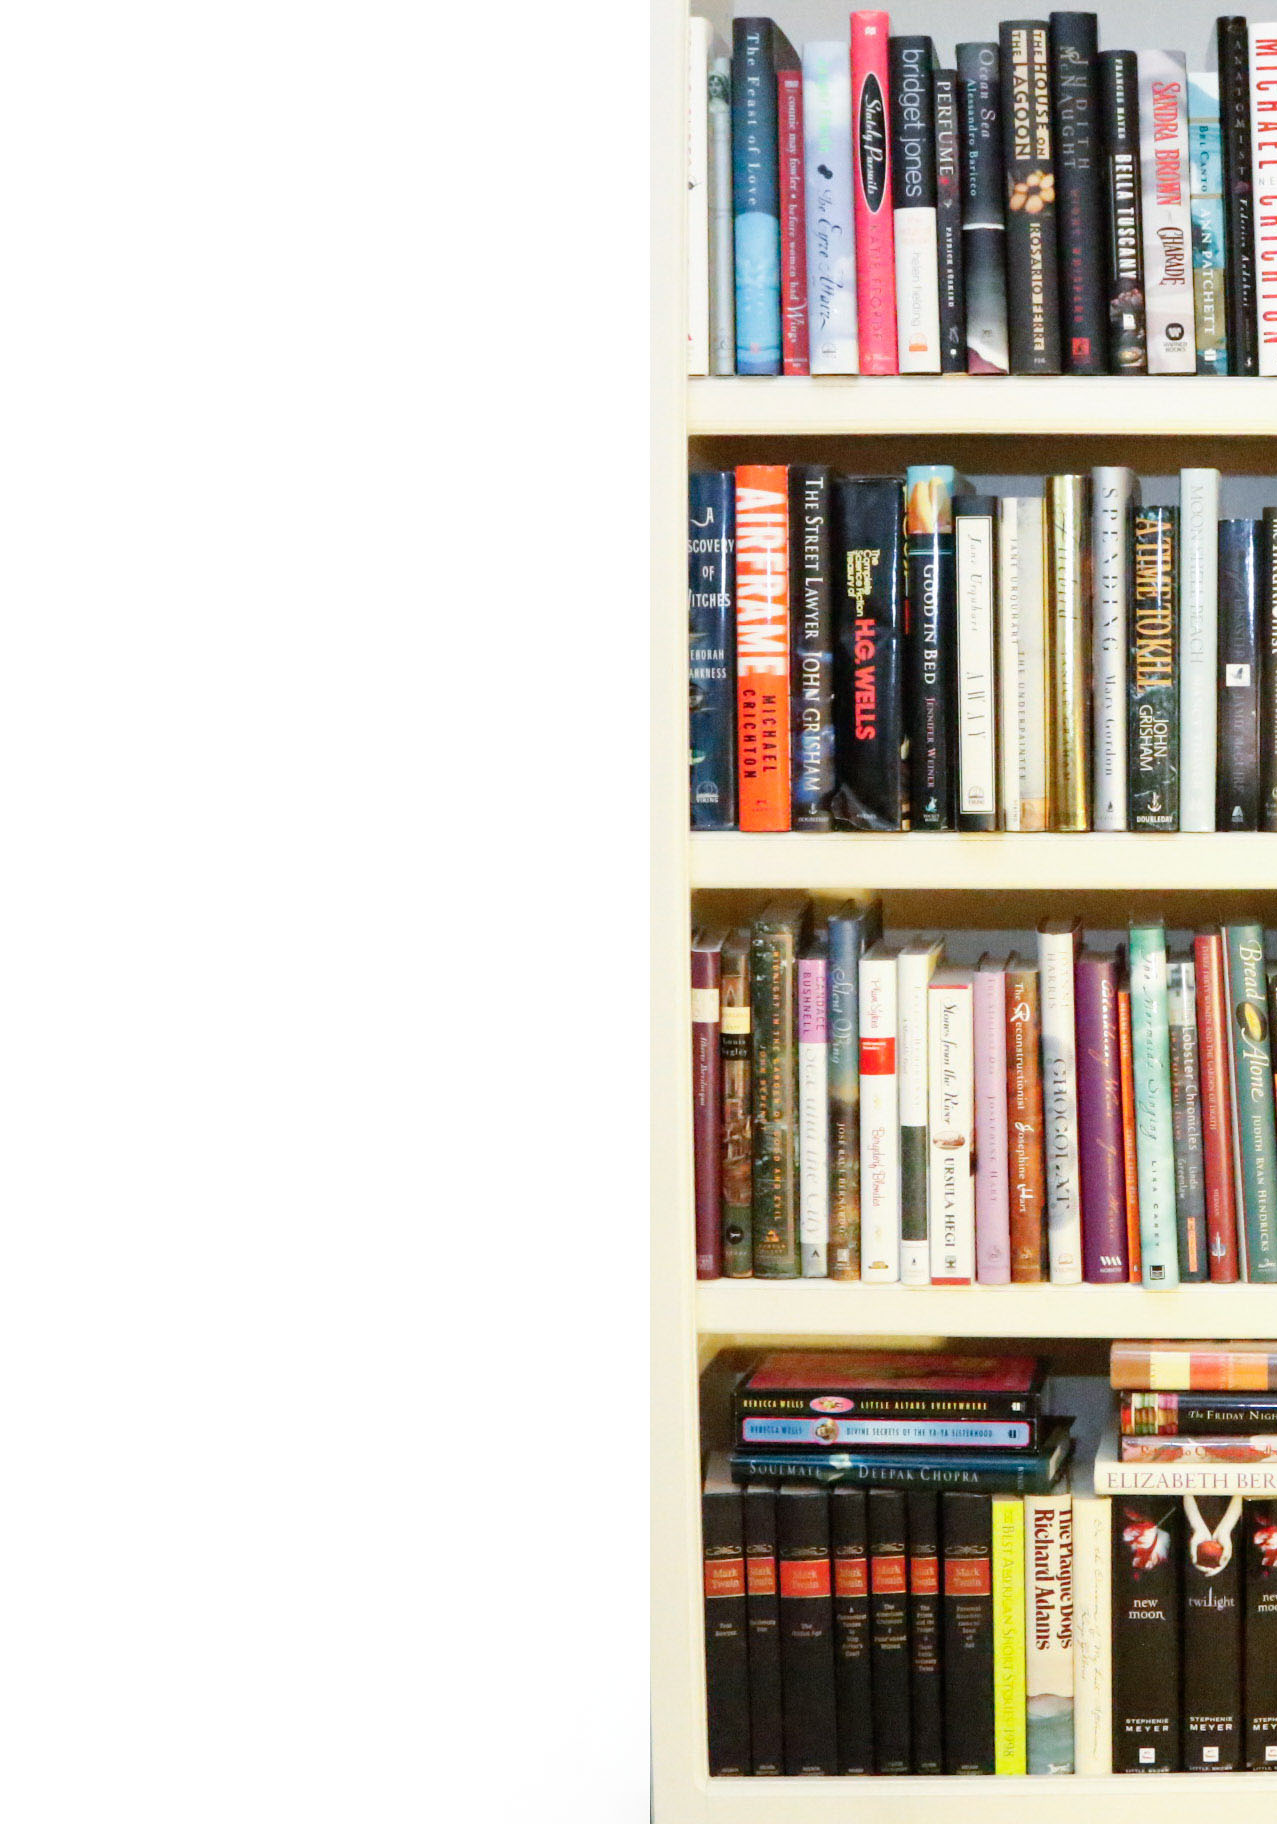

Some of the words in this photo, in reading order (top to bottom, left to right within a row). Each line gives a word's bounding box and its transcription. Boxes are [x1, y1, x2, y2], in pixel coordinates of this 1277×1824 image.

[747, 32, 760, 65] The
[1032, 30, 1043, 59] THE
[747, 77, 760, 125] Feast
[899, 49, 925, 132] bridget
[978, 50, 995, 99] Ocean
[1034, 62, 1048, 129] HOUSE
[937, 81, 955, 176] PERFUME
[980, 108, 996, 138] Sea
[1012, 62, 1030, 160] LAGOON
[1070, 49, 1091, 170] JUDITH
[1151, 80, 1180, 142] SANDRA
[748, 136, 756, 155] of
[899, 135, 922, 198] jones
[1037, 137, 1048, 157] ON
[748, 165, 761, 205] Love
[1115, 154, 1133, 202] BELLA
[1155, 148, 1182, 207] BROWN
[1117, 206, 1138, 279] TUSCANY
[1155, 226, 1186, 286] CHARADE
[804, 476, 824, 510] THE
[804, 515, 824, 572] STREET
[1136, 518, 1172, 534] A
[736, 487, 789, 677] AIRFRAME
[922, 563, 937, 619] GOOD
[1136, 536, 1172, 600] TIME
[804, 576, 824, 640] LAWYER
[923, 624, 937, 643] IN
[1136, 608, 1172, 635] TO
[801, 651, 821, 704] JOHN
[924, 649, 938, 685] BED
[1136, 639, 1173, 694] KILL
[854, 665, 876, 741] WELLS
[742, 689, 757, 779] CRICHTON
[761, 695, 777, 773] MICHAEL
[801, 707, 821, 793] GRISHAM
[1139, 704, 1153, 772] GRISHAM
[1152, 711, 1168, 757] JOHN
[1136, 815, 1174, 824] DOUBLEDAY
[1014, 982, 1024, 1000] The
[1237, 941, 1259, 999] Bread
[802, 971, 811, 1035] BUSHNELL
[1009, 1002, 1032, 1110] Reconstructionist
[1182, 1027, 1195, 1077] Lobster
[1241, 1041, 1270, 1102] Alone
[1184, 1079, 1199, 1151] Chronicles
[943, 1158, 956, 1211] URSULA
[944, 1217, 956, 1248] HEGI
[860, 1402, 889, 1410] LITTLE
[894, 1402, 926, 1411] ALTARS
[931, 1402, 988, 1411] EVERYWHERE
[1107, 1472, 1233, 1489] ELIZABETH
[1034, 1509, 1054, 1582] Richard
[1034, 1586, 1052, 1650] Adams
[1128, 1609, 1166, 1621] moon
[1133, 1599, 1159, 1609] new
[1188, 1586, 1236, 1611] twilight
[1125, 1724, 1169, 1732] MEYER
[1189, 1722, 1233, 1731] MEYER
